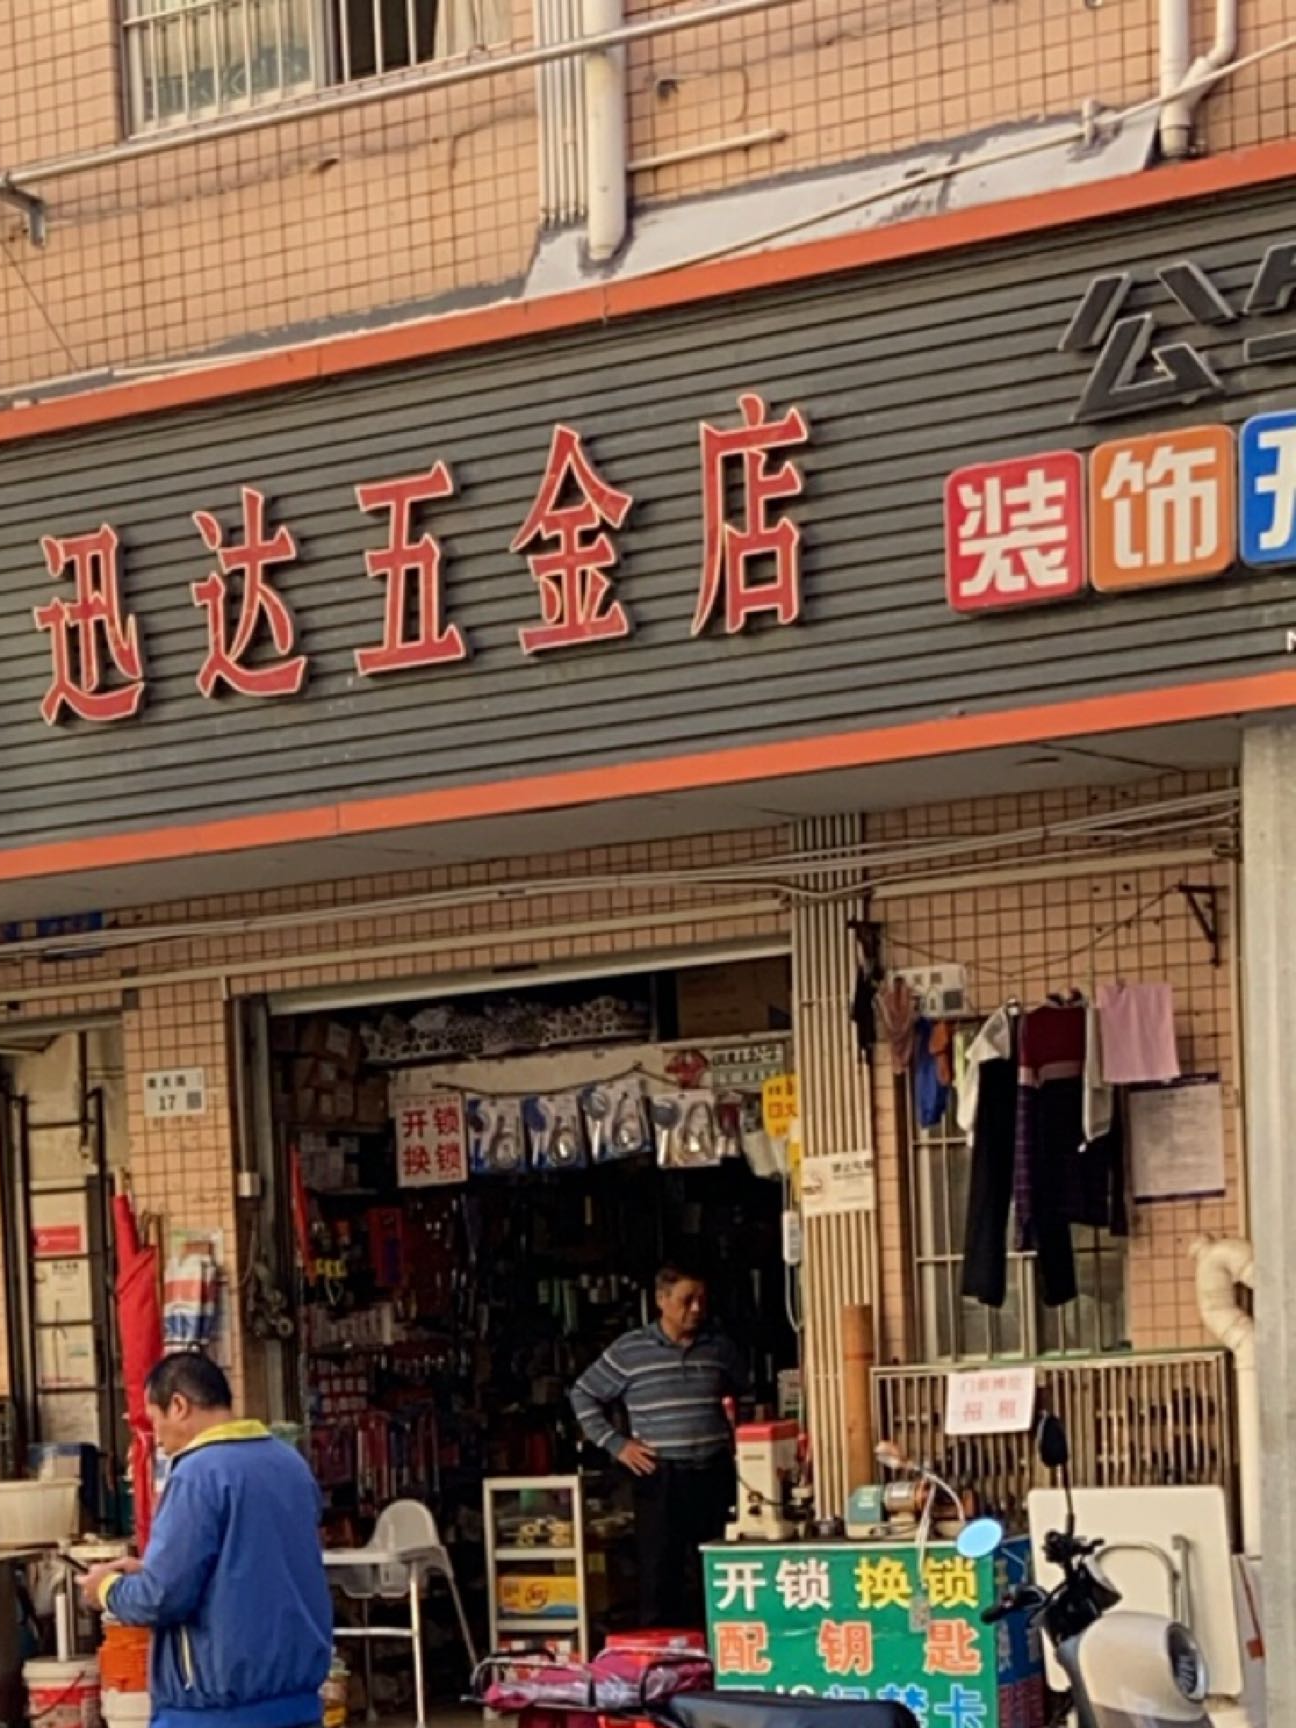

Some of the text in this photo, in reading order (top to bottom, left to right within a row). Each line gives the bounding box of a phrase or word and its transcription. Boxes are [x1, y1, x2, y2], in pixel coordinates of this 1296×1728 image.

[33, 393, 809, 726] 迅达五金店
[402, 1106, 460, 1138] 开锁
[403, 1143, 462, 1176] 换锁
[713, 1556, 980, 1611] 开锁 换锁
[713, 1617, 983, 1677] 配钥匙
